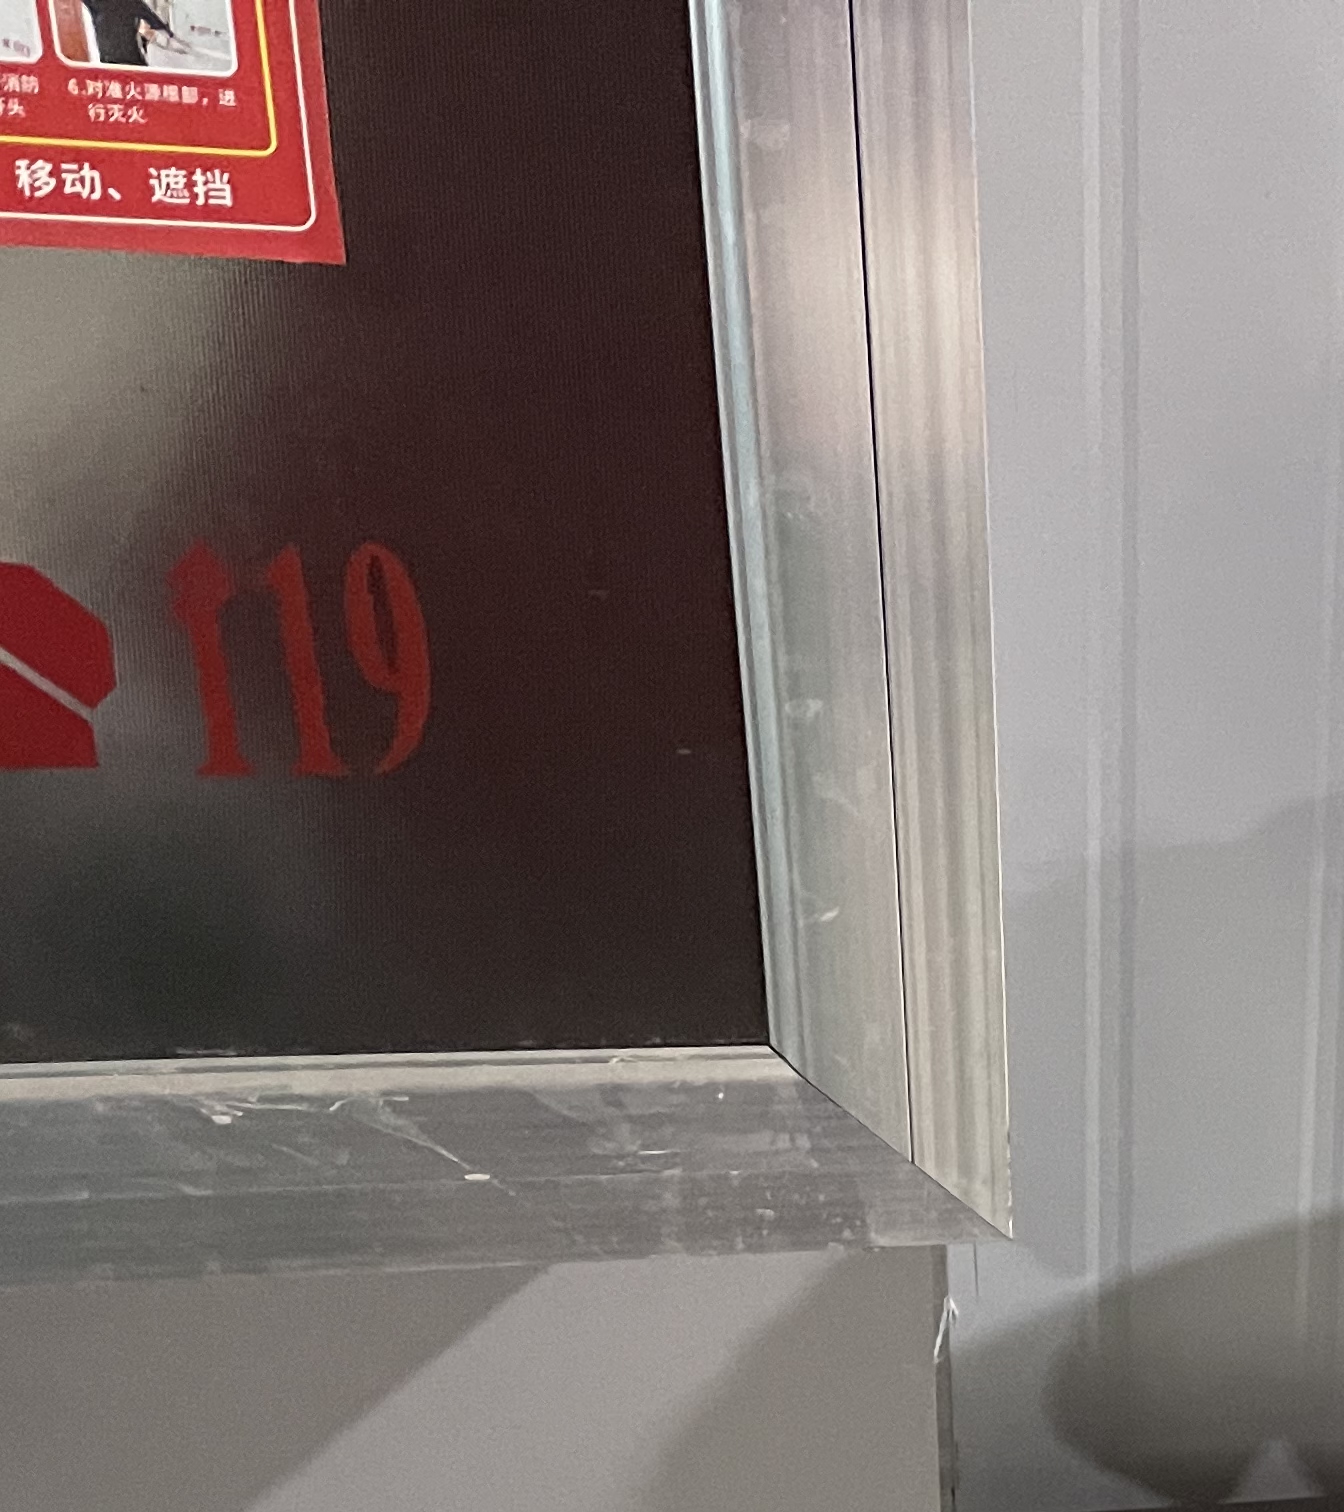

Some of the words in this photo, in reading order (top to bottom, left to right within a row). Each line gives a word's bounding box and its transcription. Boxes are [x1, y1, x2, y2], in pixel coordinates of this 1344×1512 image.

[88, 103, 147, 123] 行灭火
[14, 158, 234, 208] 移动、遮挡
[166, 538, 431, 778] 119
